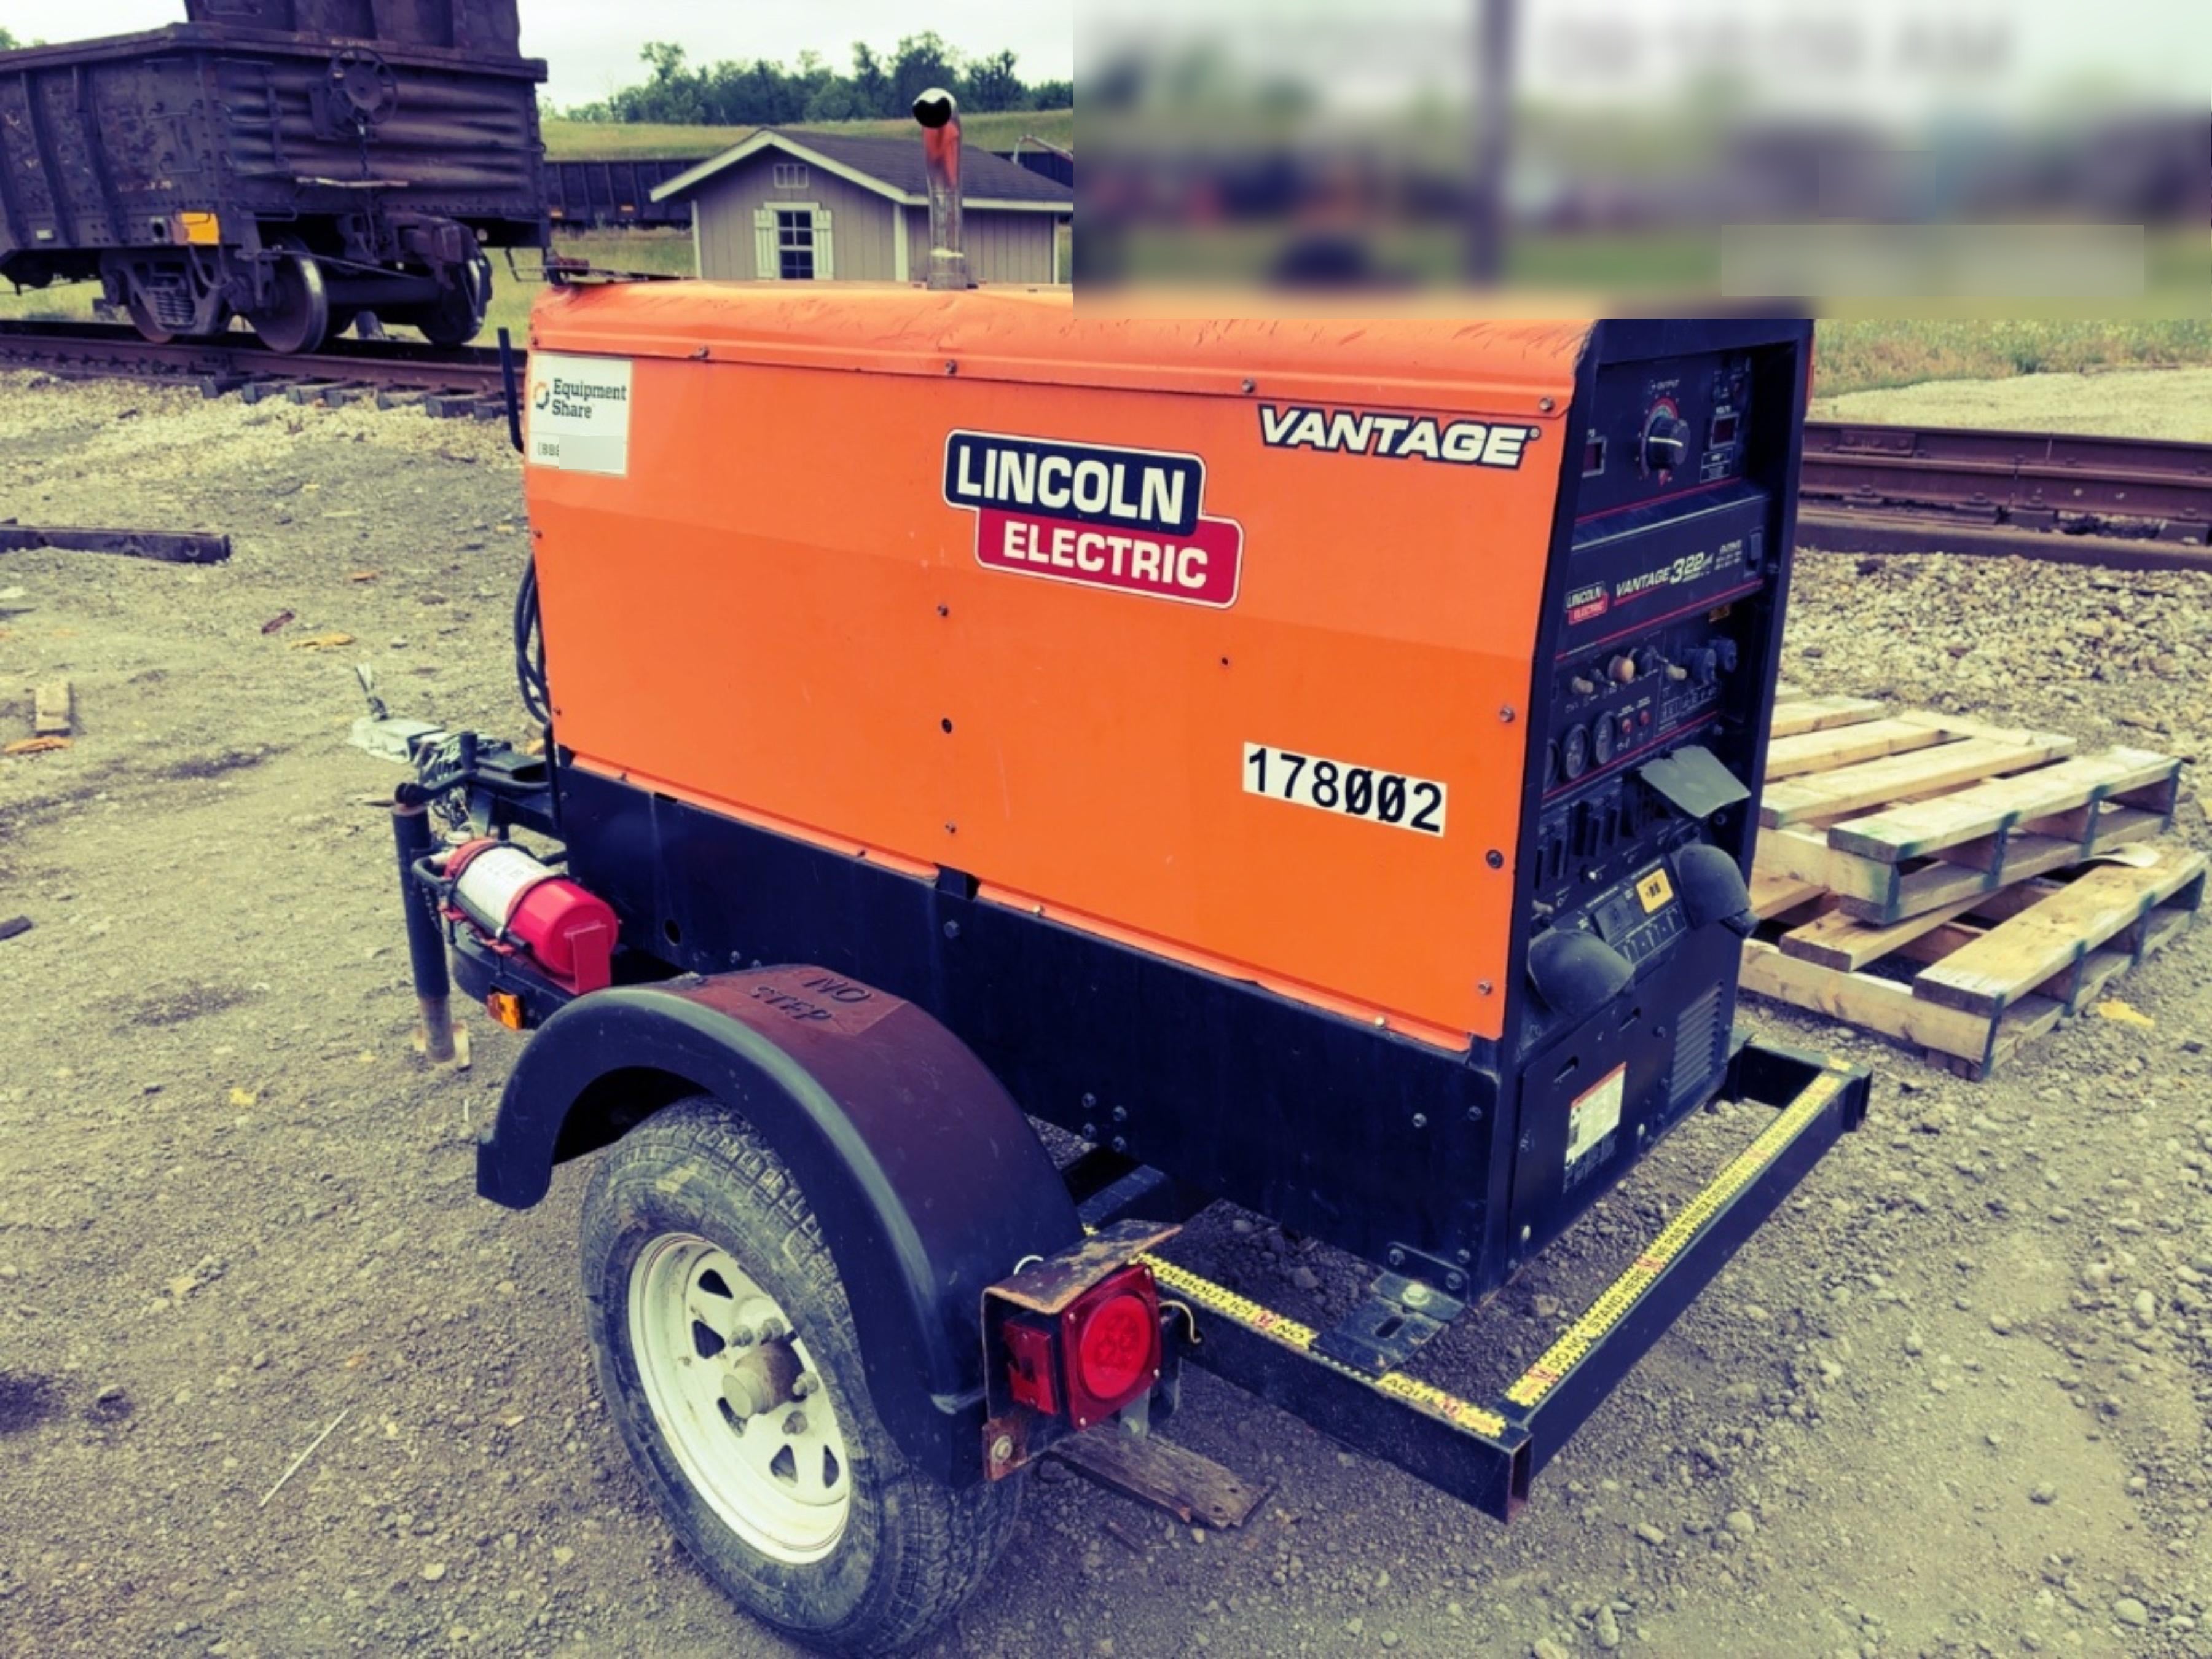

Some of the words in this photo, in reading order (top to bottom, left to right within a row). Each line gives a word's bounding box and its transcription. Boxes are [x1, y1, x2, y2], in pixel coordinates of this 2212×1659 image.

[554, 378, 627, 401] Equipment
[552, 399, 592, 418] Share
[957, 445, 1185, 524] LINCOLN
[1003, 520, 1208, 589] ELECTRIC
[1616, 567, 1671, 597] VANTAGE
[1669, 552, 1704, 584] 322
[1249, 748, 1442, 833] 178002
[751, 987, 832, 1019] STEP
[802, 978, 872, 1002] NO
[1158, 1267, 1227, 1302] DEBOUT
[1586, 1295, 1625, 1328] STAND
[1275, 1325, 1306, 1340] NO
